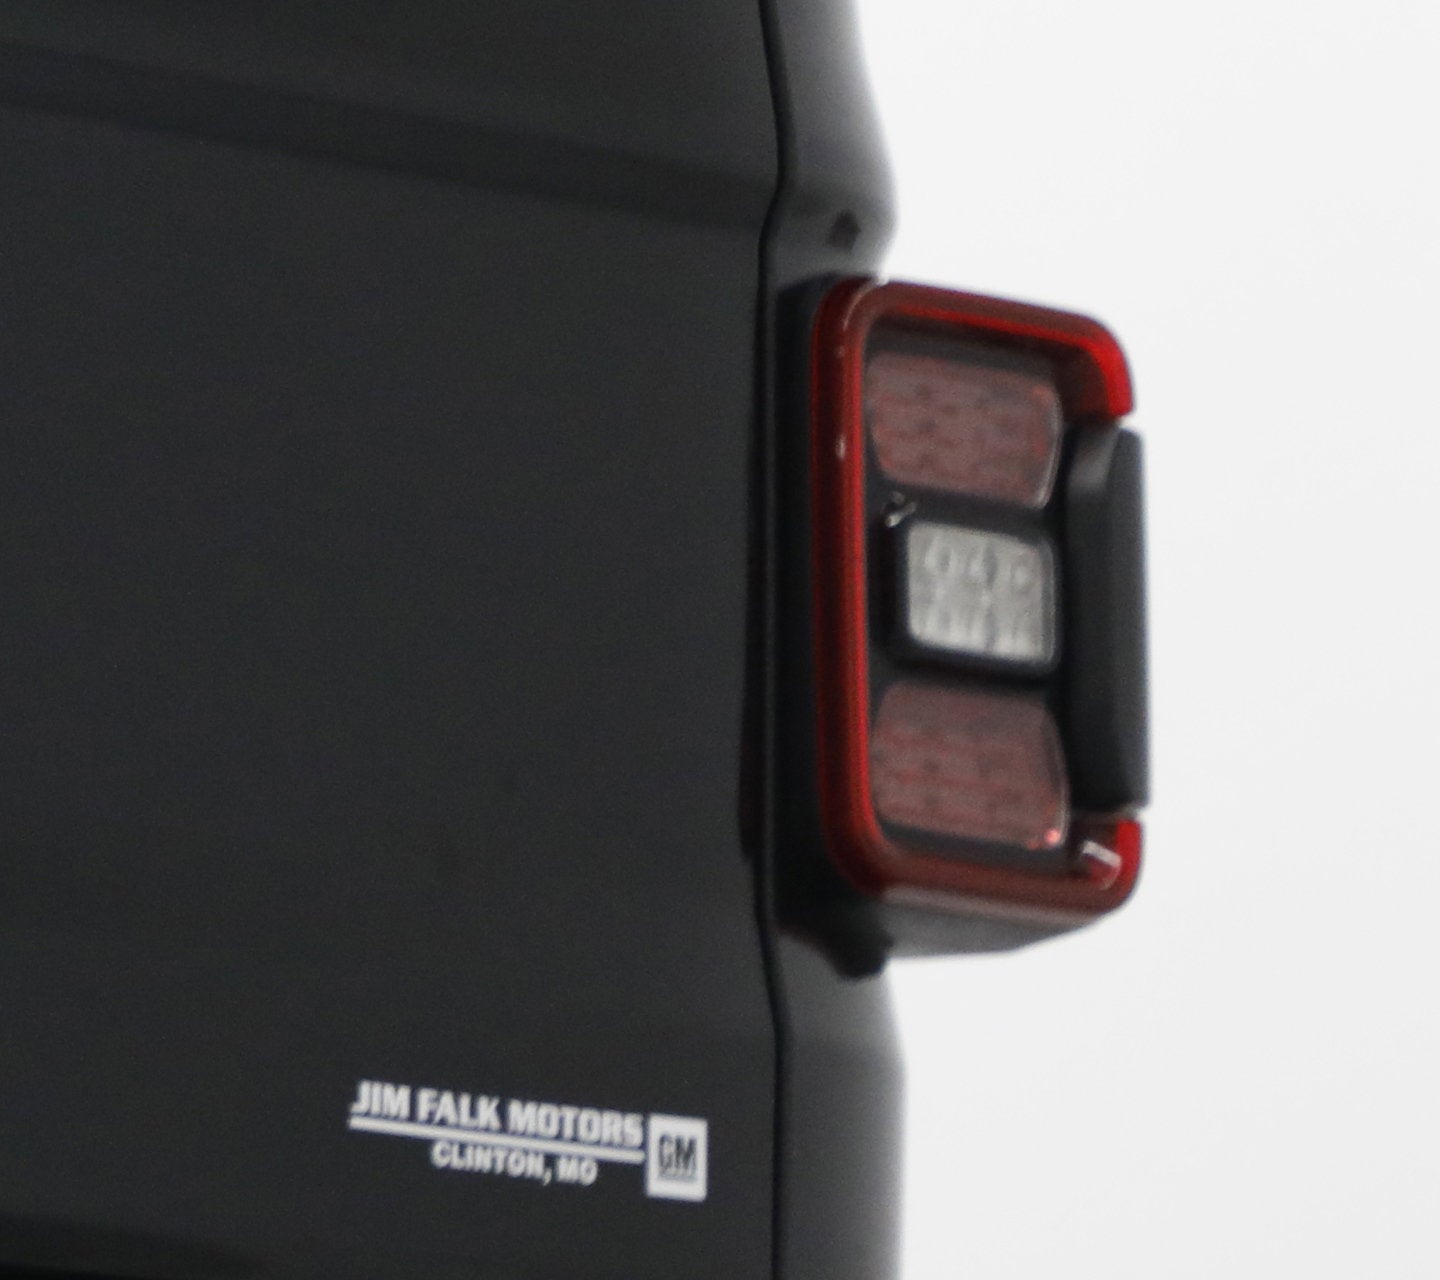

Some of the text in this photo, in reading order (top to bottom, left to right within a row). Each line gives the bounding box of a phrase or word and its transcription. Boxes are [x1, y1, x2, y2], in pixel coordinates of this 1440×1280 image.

[351, 1080, 644, 1149] JIM FALK MOTORS
[431, 1138, 598, 1186] CLINTON, MO
[658, 1132, 697, 1176] GM
